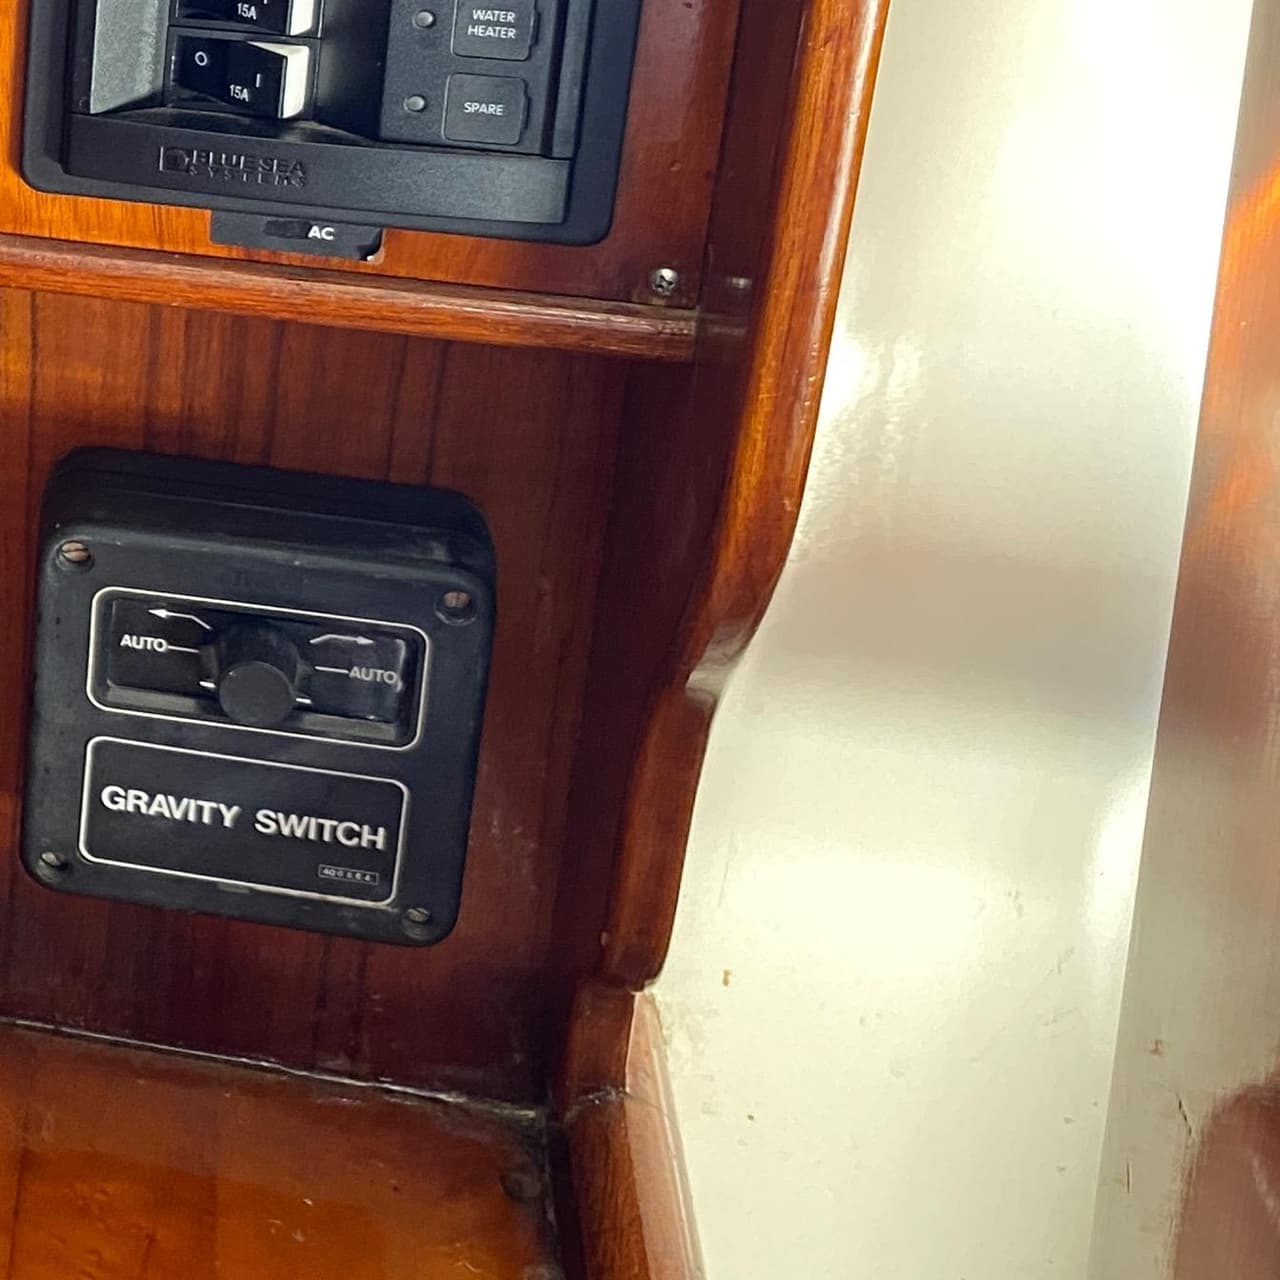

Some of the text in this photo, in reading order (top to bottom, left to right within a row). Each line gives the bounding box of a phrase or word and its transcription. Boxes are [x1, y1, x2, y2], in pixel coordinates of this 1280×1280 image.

[237, 3, 257, 20] 15A
[472, 9, 515, 22] WATER
[467, 25, 516, 39] HEATER
[229, 84, 249, 102] 15A
[463, 101, 504, 116] SPARE
[308, 225, 335, 241] AC
[120, 634, 168, 653] AUTO
[349, 665, 398, 684] AUTO
[100, 784, 387, 851] GRAVITY SWITCH
